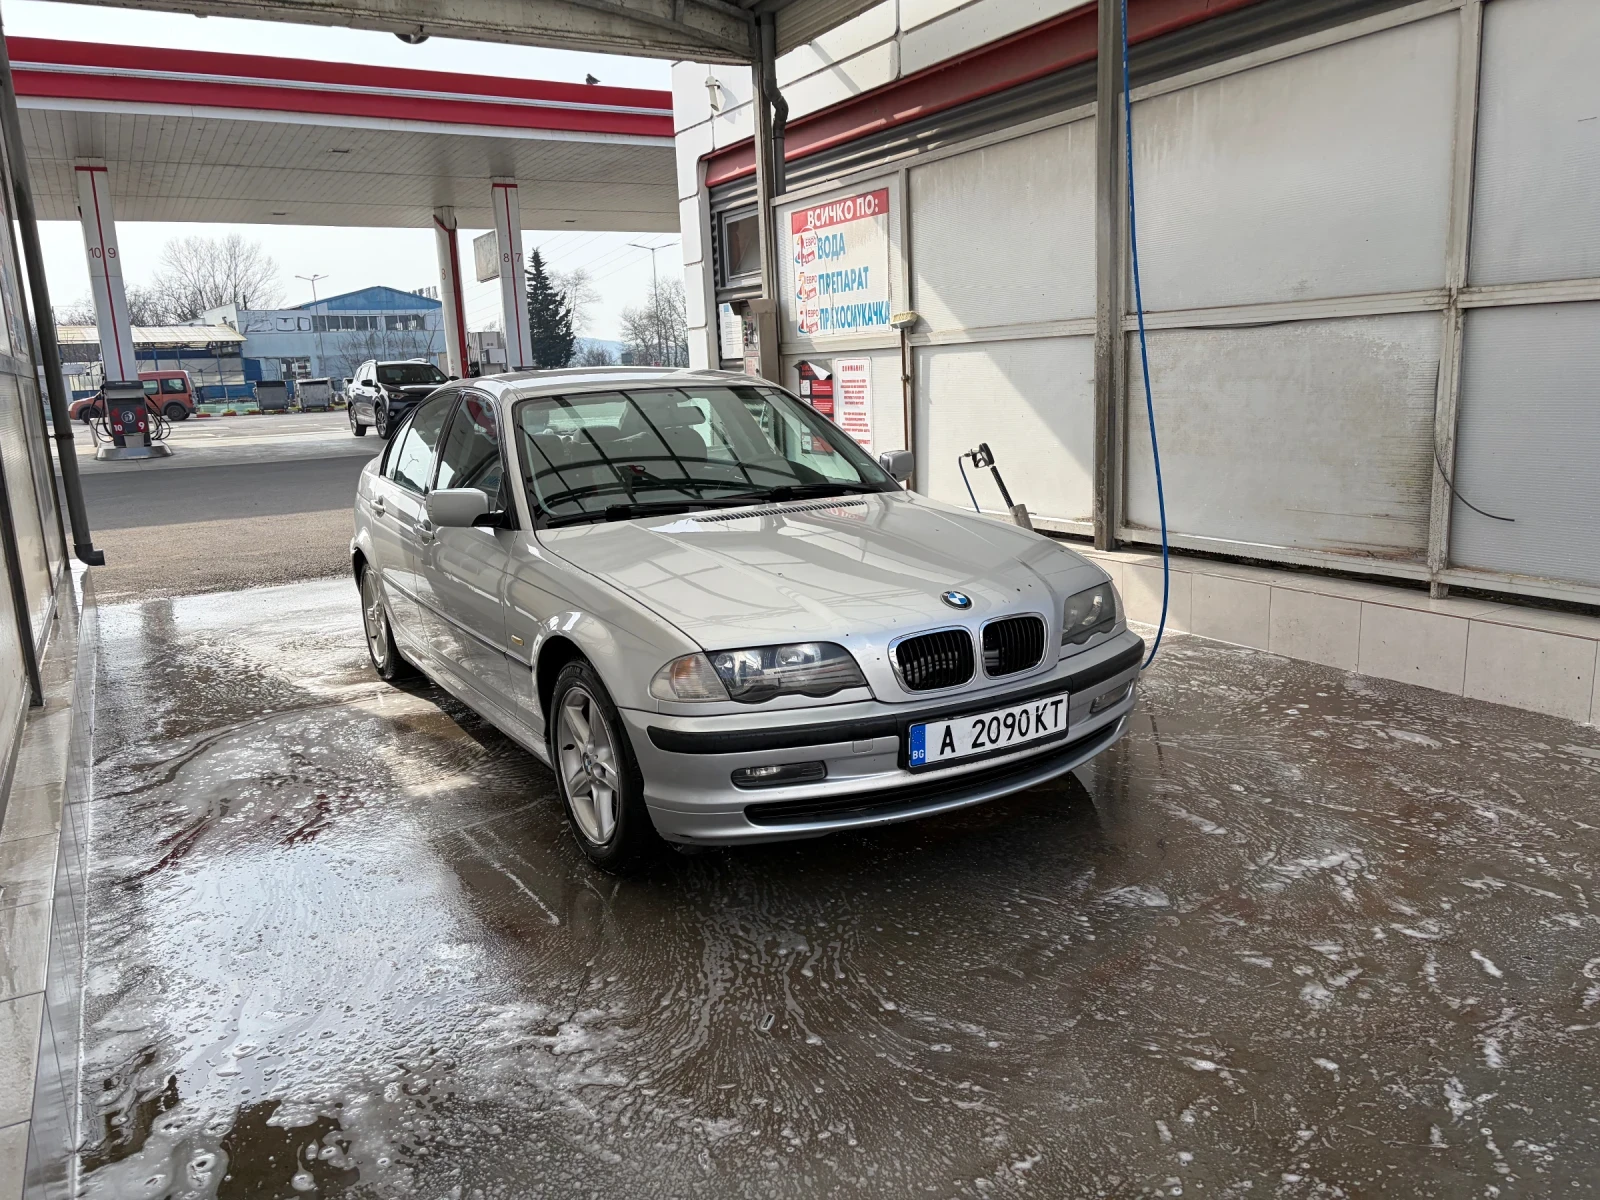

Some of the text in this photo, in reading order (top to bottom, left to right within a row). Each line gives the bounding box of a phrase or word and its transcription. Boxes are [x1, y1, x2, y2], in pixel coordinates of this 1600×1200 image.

[807, 194, 879, 228] ВСИЧКО ПО:
[88, 247, 116, 259] 10 9
[503, 252, 522, 263] 8 7
[817, 233, 846, 261] ВОДА
[818, 266, 869, 295] ПРЕПАРАТ
[819, 300, 890, 330] ПРХОСМУКАЧКА
[113, 421, 145, 432] 10 9
[939, 724, 956, 756] A
[912, 749, 925, 760] BG
